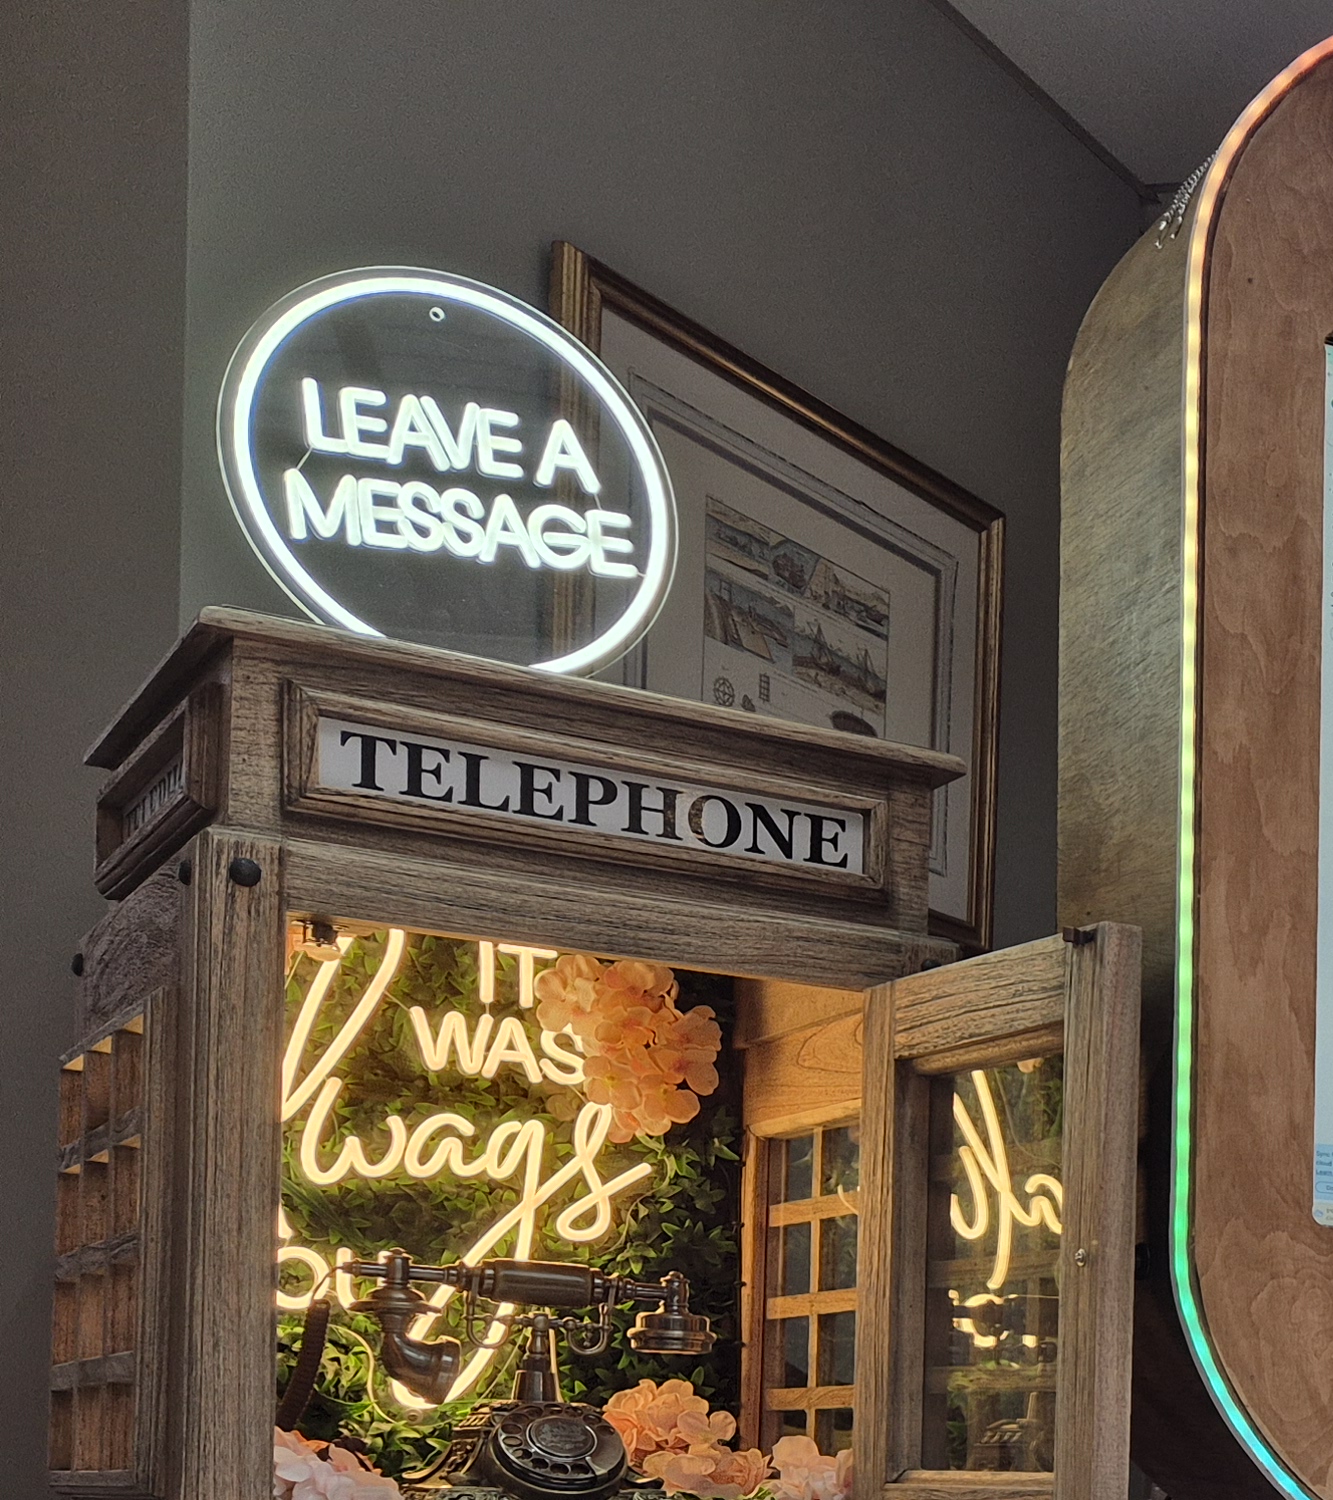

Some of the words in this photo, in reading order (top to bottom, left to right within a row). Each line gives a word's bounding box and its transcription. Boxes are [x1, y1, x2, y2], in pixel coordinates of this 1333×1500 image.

[301, 376, 525, 479] LEAVE
[533, 418, 602, 496] A
[283, 466, 640, 581] MESSAGE
[340, 731, 849, 869] TELEPHONE
[480, 940, 558, 1009] IT
[410, 1006, 589, 1087] WAS
[1317, 1151, 1330, 1159] Sync
